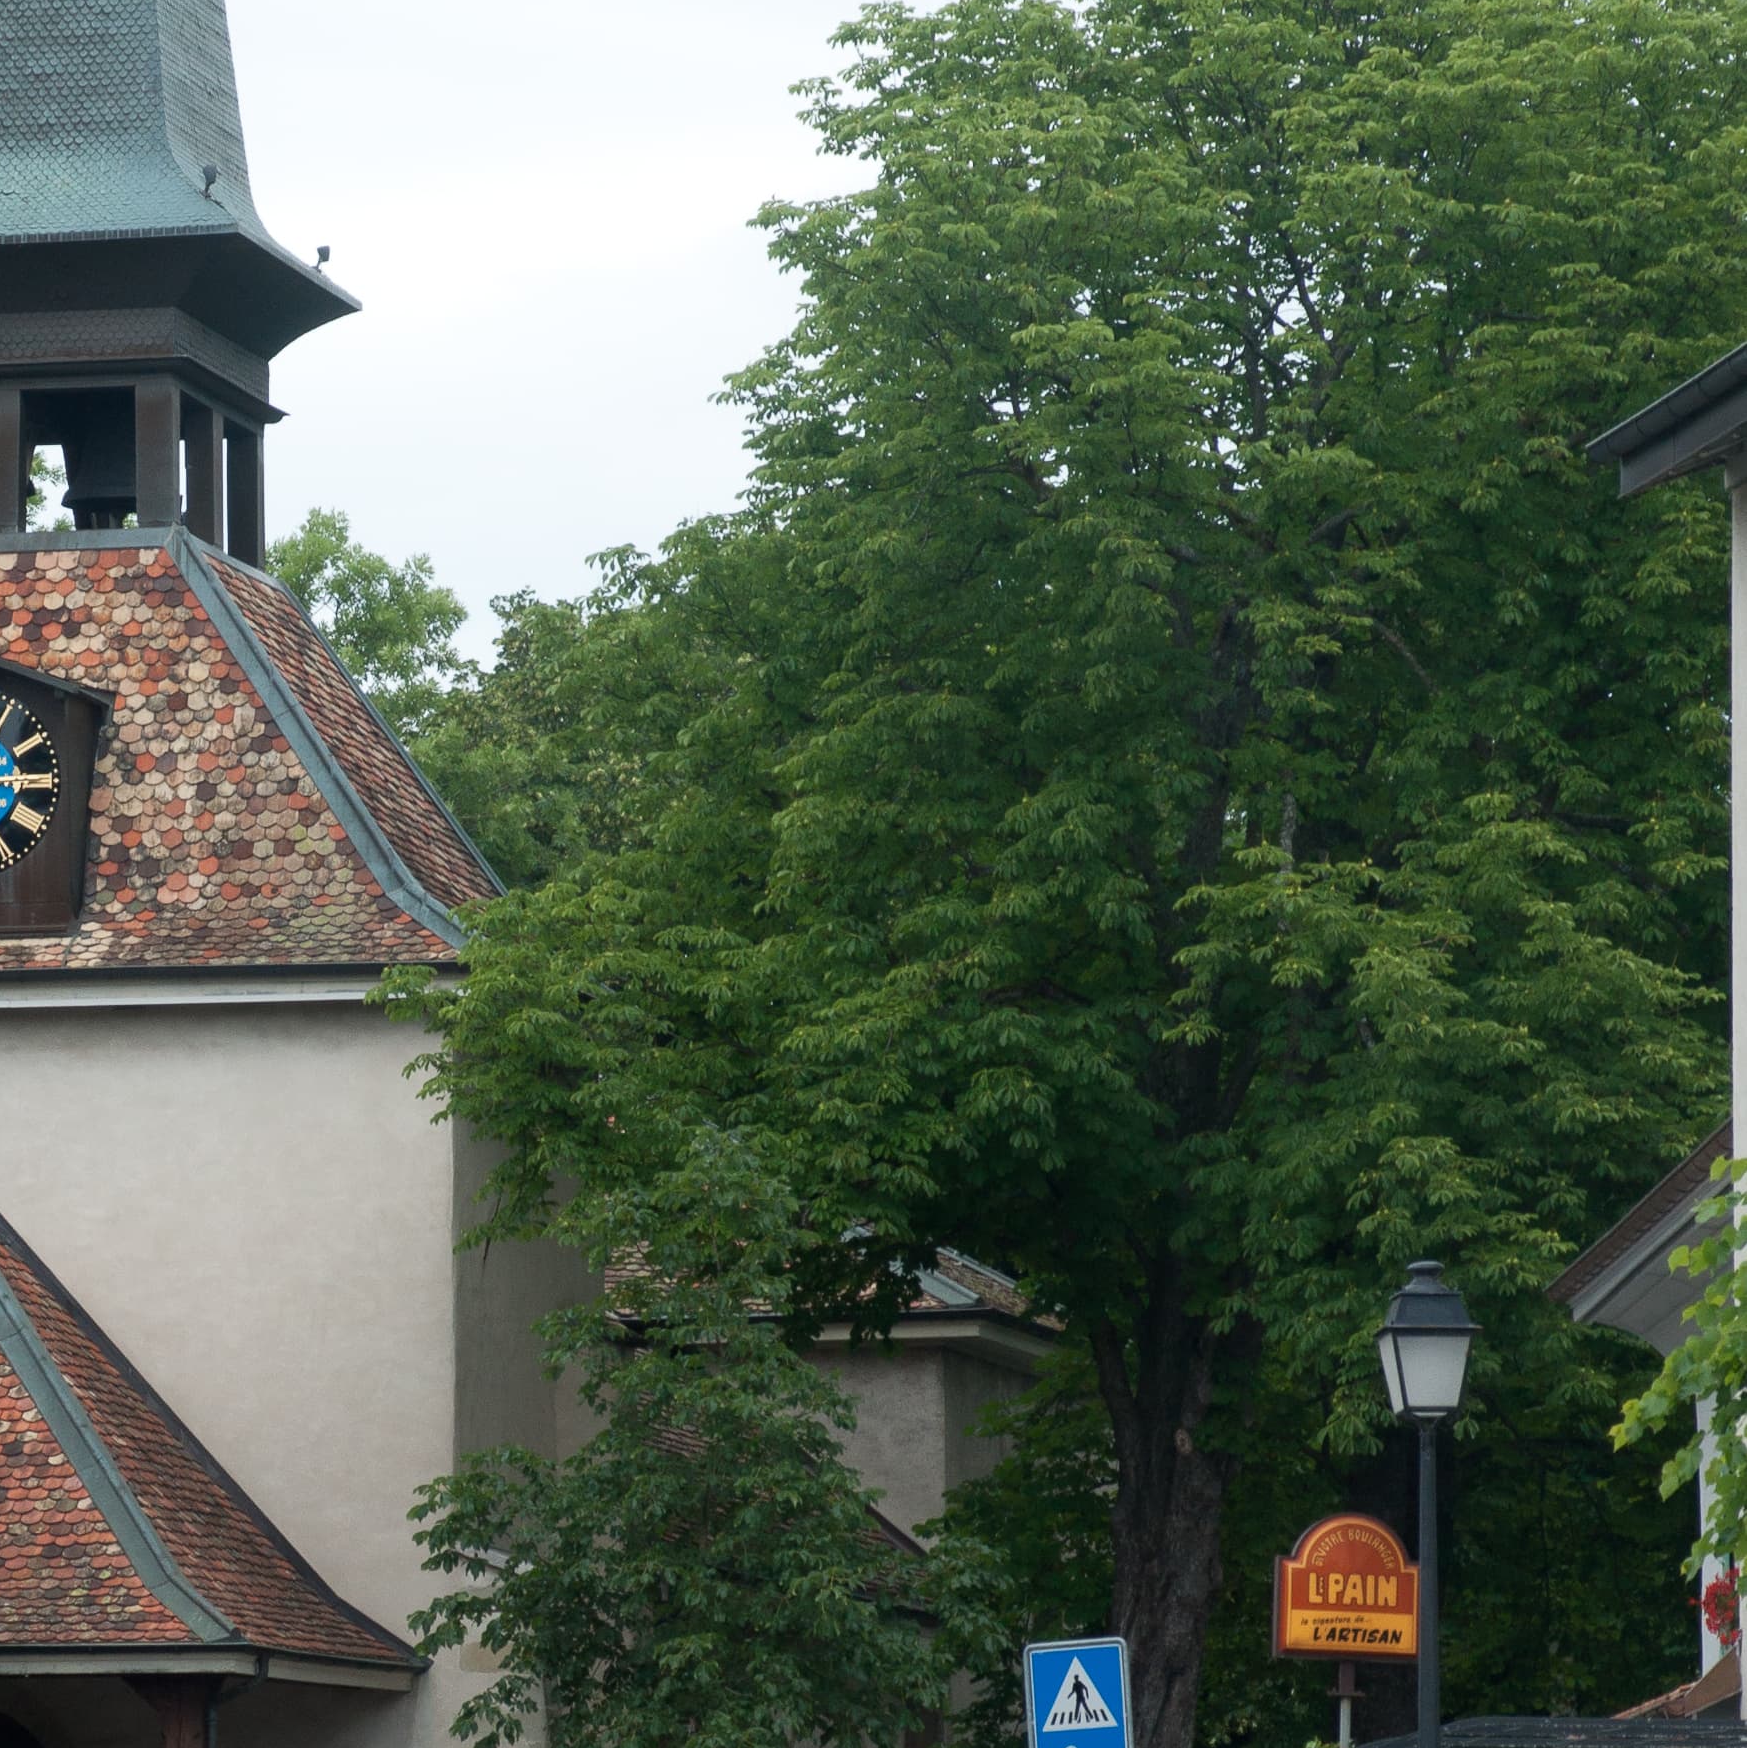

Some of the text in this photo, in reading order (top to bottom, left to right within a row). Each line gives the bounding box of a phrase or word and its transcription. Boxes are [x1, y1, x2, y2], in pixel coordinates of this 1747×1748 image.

[13, 732, 43, 757] II
[1348, 1529, 1395, 1569] BOULANGER
[1328, 1572, 1398, 1607] PAIN
[1313, 1627, 1402, 1644] L'ARTISAN
